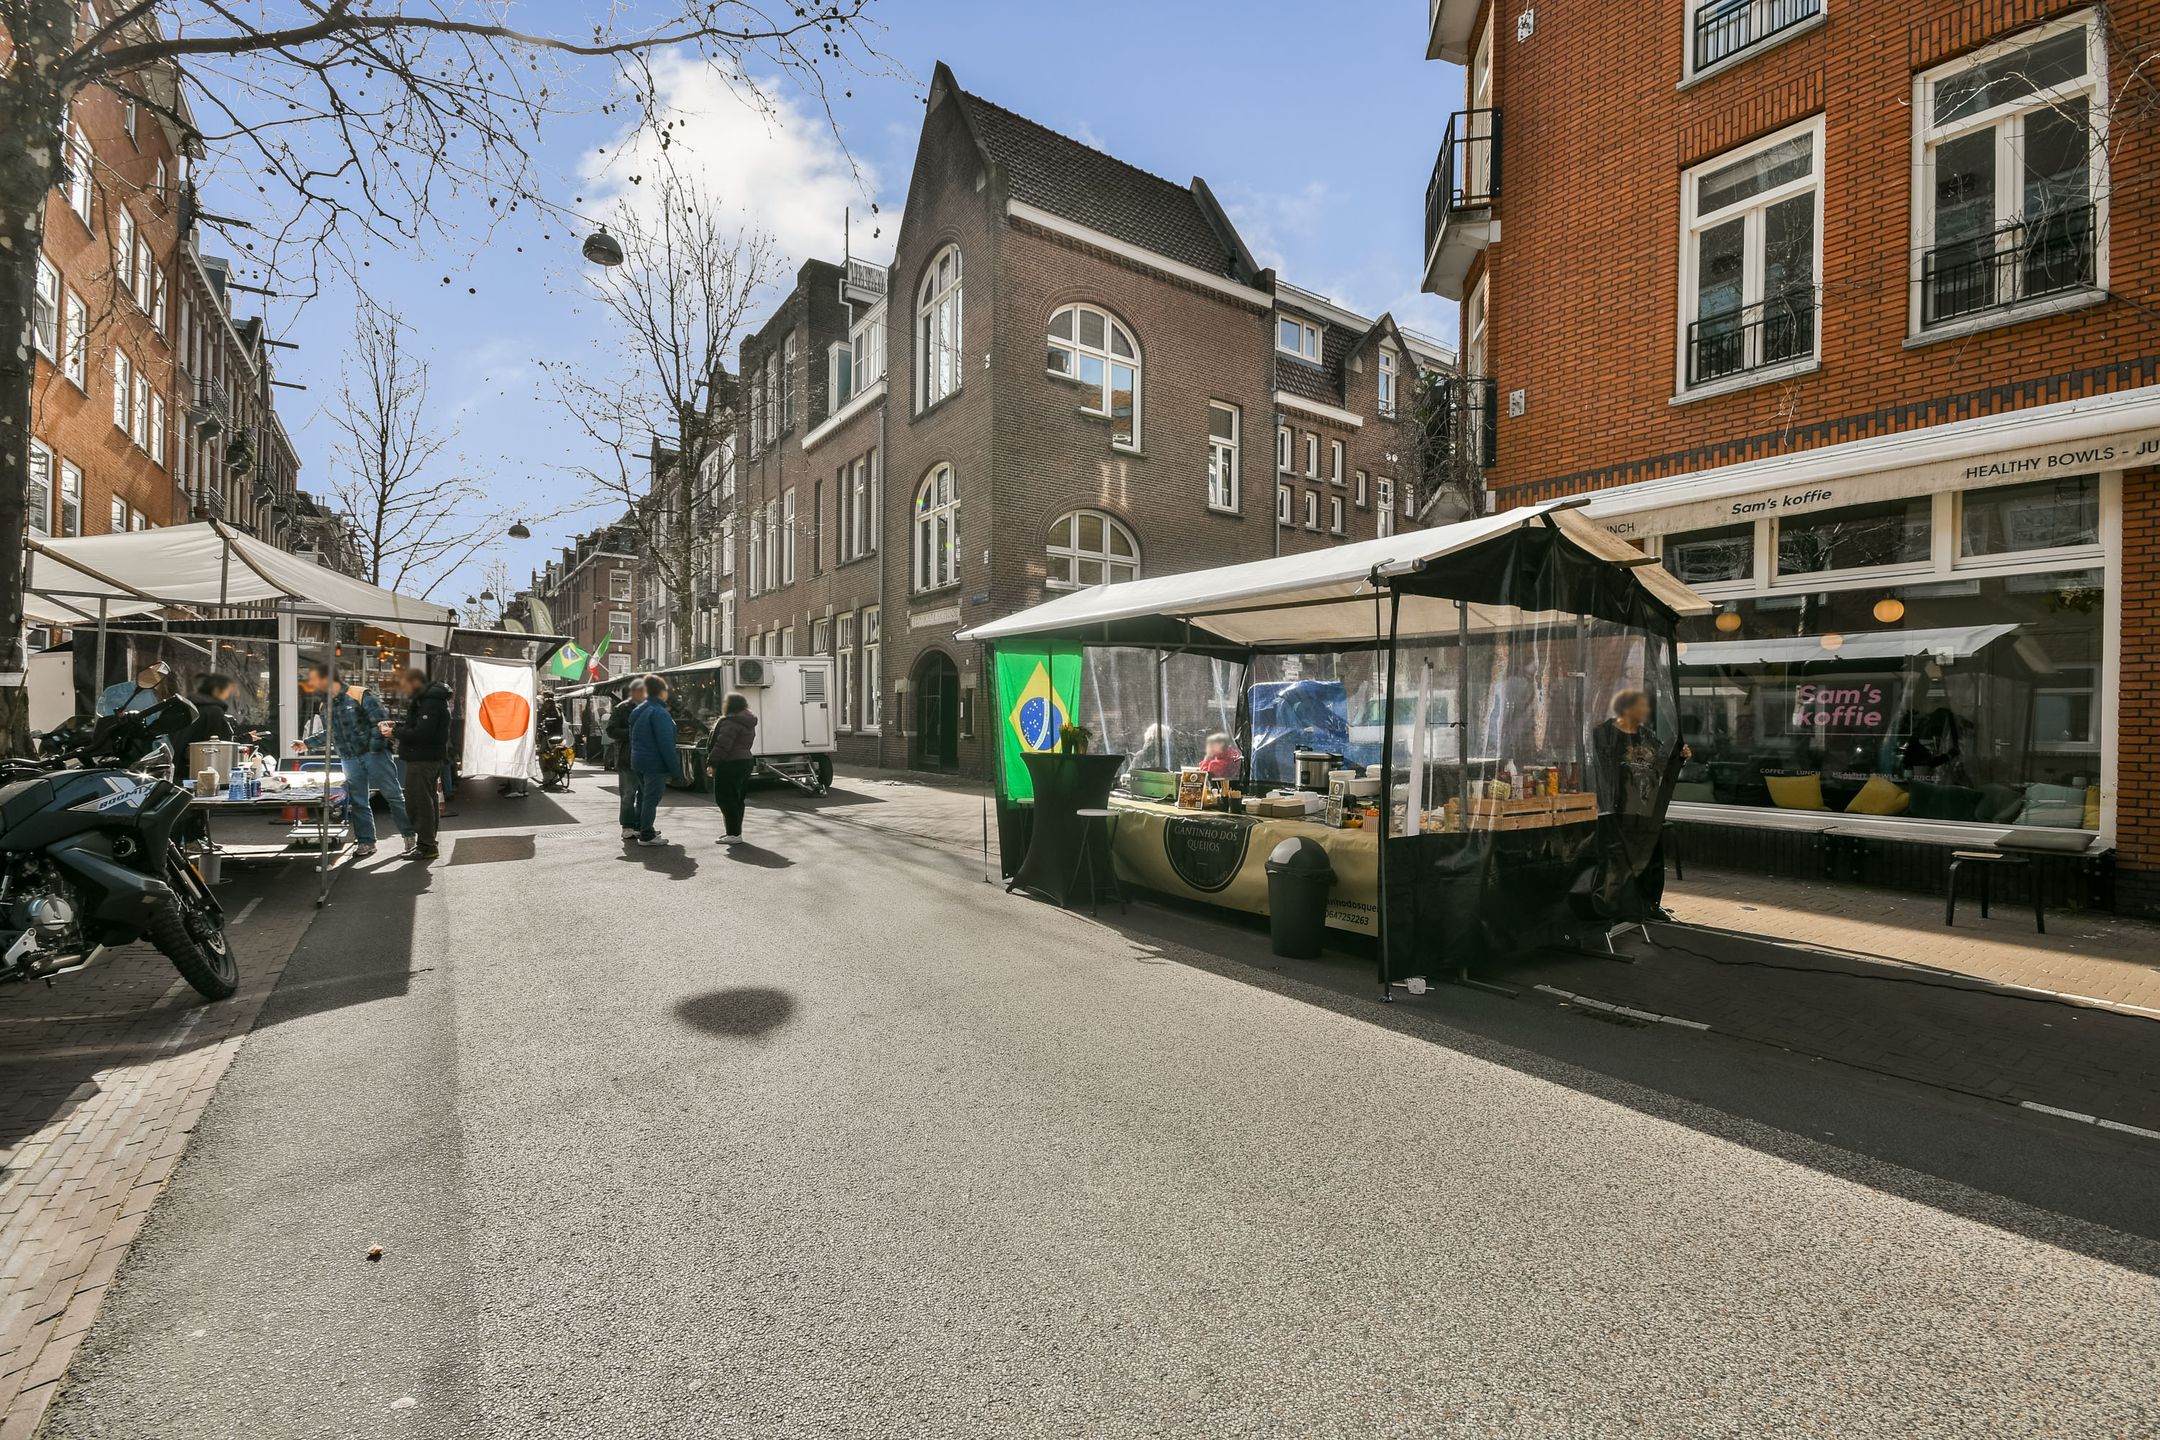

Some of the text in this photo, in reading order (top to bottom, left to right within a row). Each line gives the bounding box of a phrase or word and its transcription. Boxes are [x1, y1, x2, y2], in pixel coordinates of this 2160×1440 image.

[1966, 457, 2041, 479] HEALTHY
[2047, 447, 2114, 468] BOWLS
[2136, 439, 2160, 455] JU
[1731, 489, 1832, 515] Sam's koffie
[1606, 522, 1634, 534] NCH
[1799, 683, 1882, 704] Sam's
[1799, 705, 1882, 726] koffie
[1174, 825, 1238, 841] CANTINHO DOS
[1187, 840, 1220, 852] QUEIJOS
